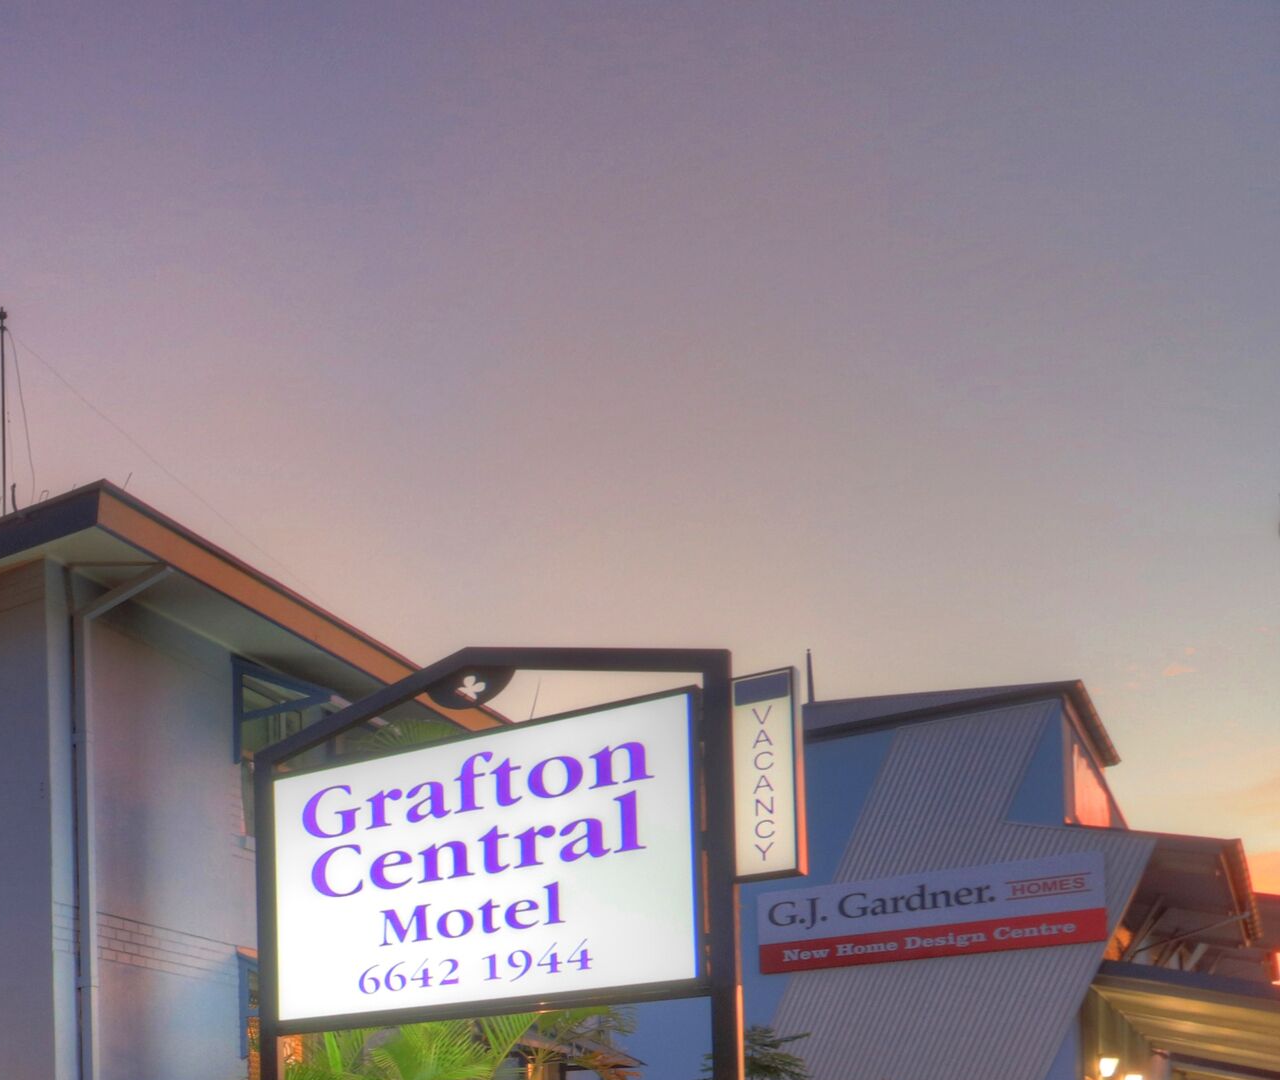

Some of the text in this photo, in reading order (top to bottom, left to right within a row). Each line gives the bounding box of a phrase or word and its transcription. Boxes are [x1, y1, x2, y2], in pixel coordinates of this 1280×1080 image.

[301, 738, 655, 840] Grafton
[752, 705, 776, 862] VACANCY
[310, 790, 647, 898] Central
[378, 880, 567, 947] Motel
[767, 883, 996, 930] G.J. Gardner.
[1011, 877, 1086, 897] HOMES
[357, 938, 594, 995] 6642 1944
[782, 922, 1077, 963] New Home Design Centre
